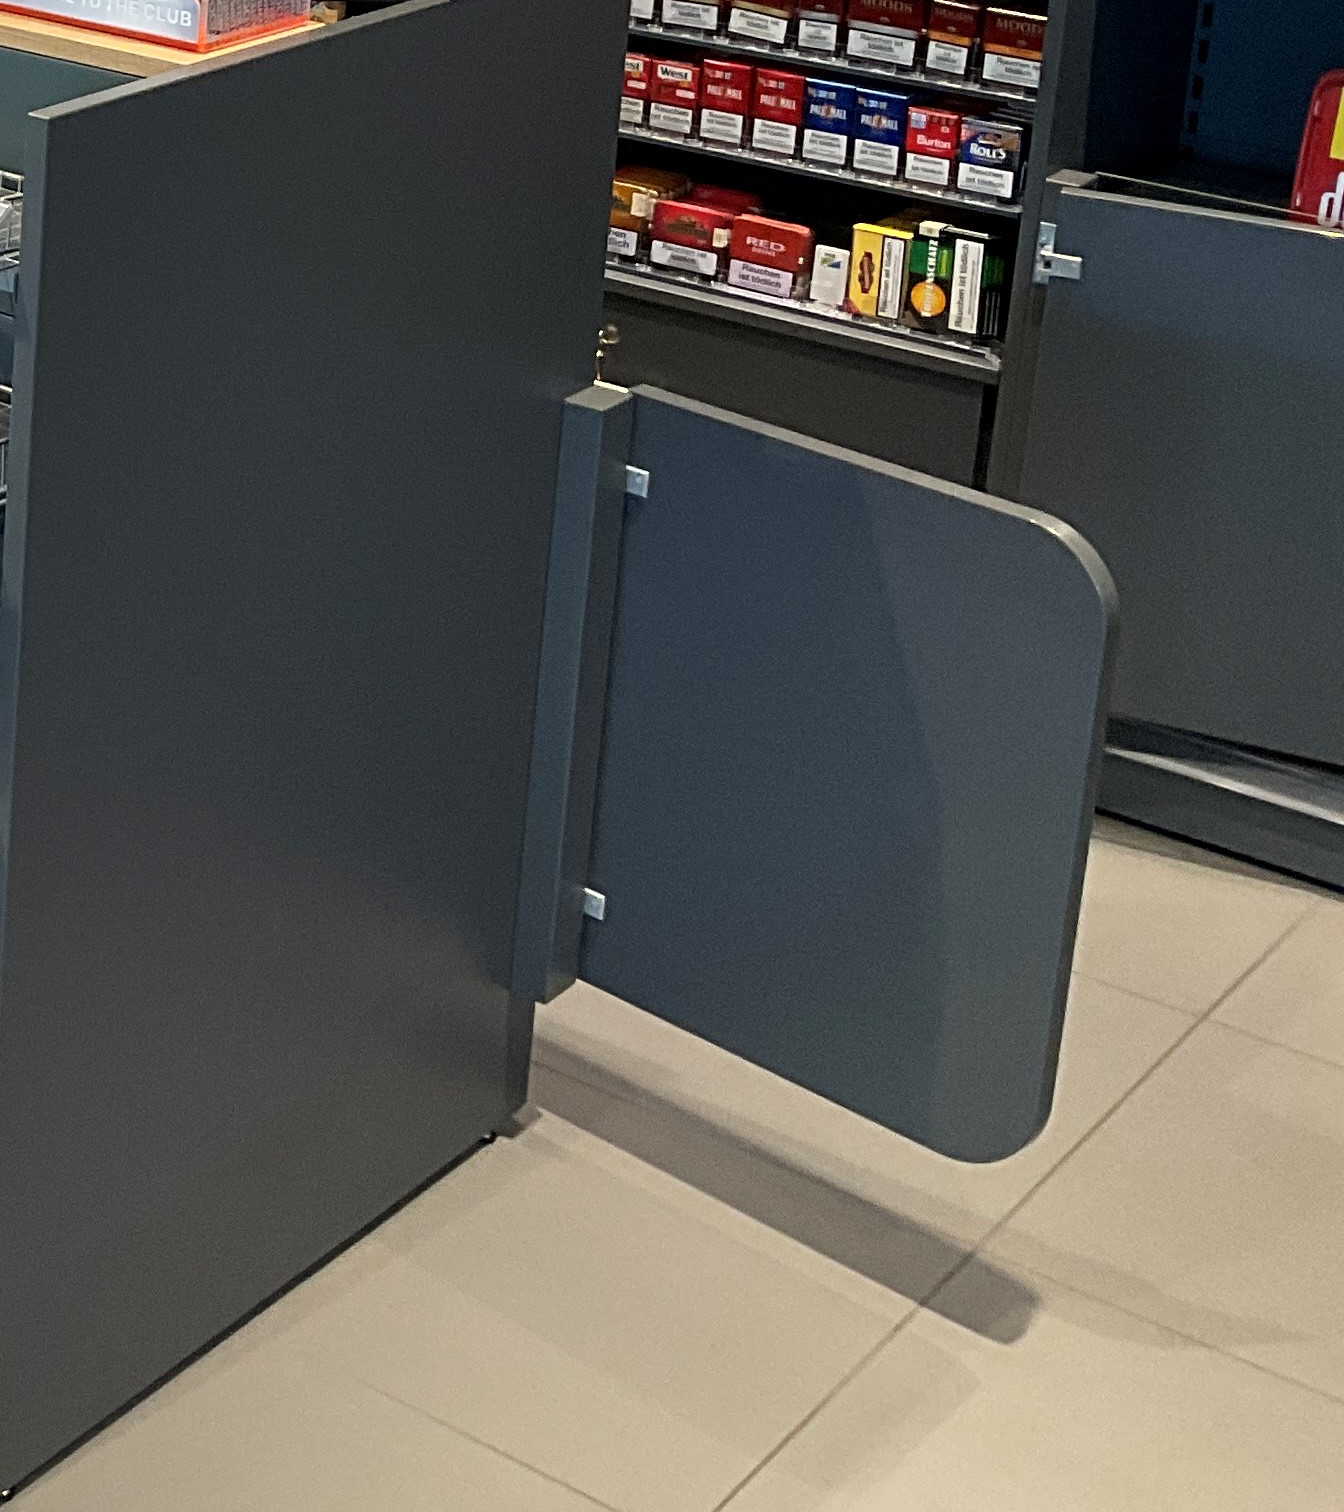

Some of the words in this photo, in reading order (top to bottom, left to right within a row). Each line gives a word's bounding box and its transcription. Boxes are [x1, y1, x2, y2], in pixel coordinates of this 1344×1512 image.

[143, 4, 192, 27] CLUB
[658, 65, 691, 80] West
[916, 135, 951, 150] Burton
[746, 236, 787, 252] RED
[741, 262, 781, 279] Rauchen
[738, 273, 750, 283] ist
[751, 276, 781, 289] tödlich
